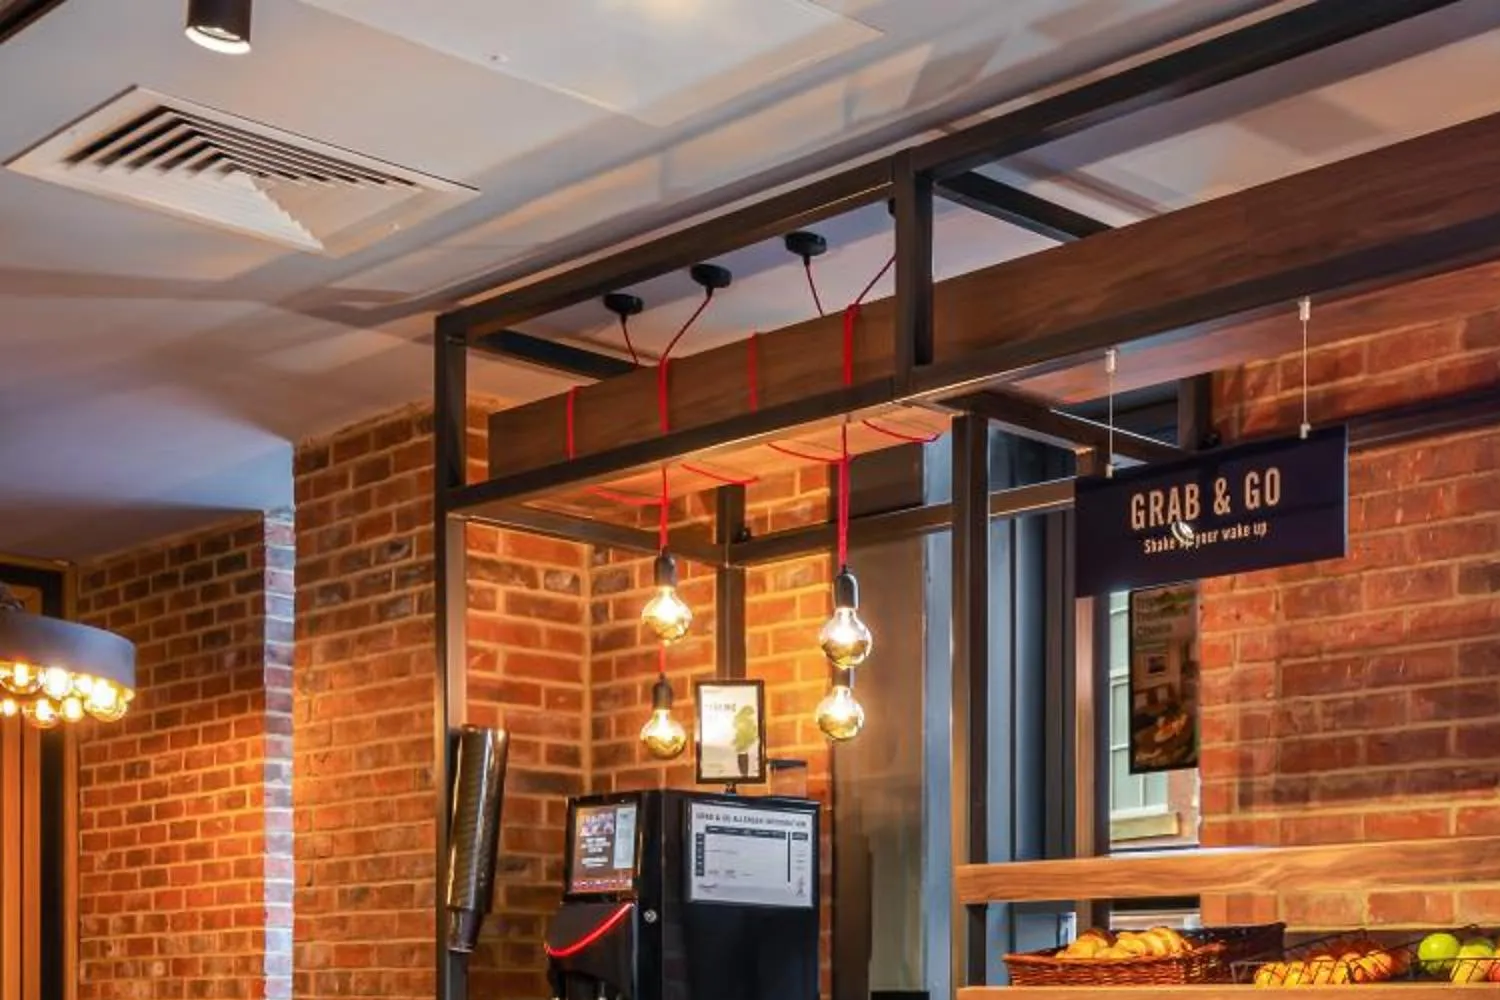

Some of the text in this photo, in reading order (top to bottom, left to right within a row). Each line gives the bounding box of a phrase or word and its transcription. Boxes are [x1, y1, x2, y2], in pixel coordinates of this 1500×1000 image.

[1131, 466, 1281, 531] GRAB & GO
[1143, 536, 1176, 554] Shake
[1195, 529, 1218, 549] your
[1221, 522, 1250, 541] wake
[1253, 520, 1268, 537] up
